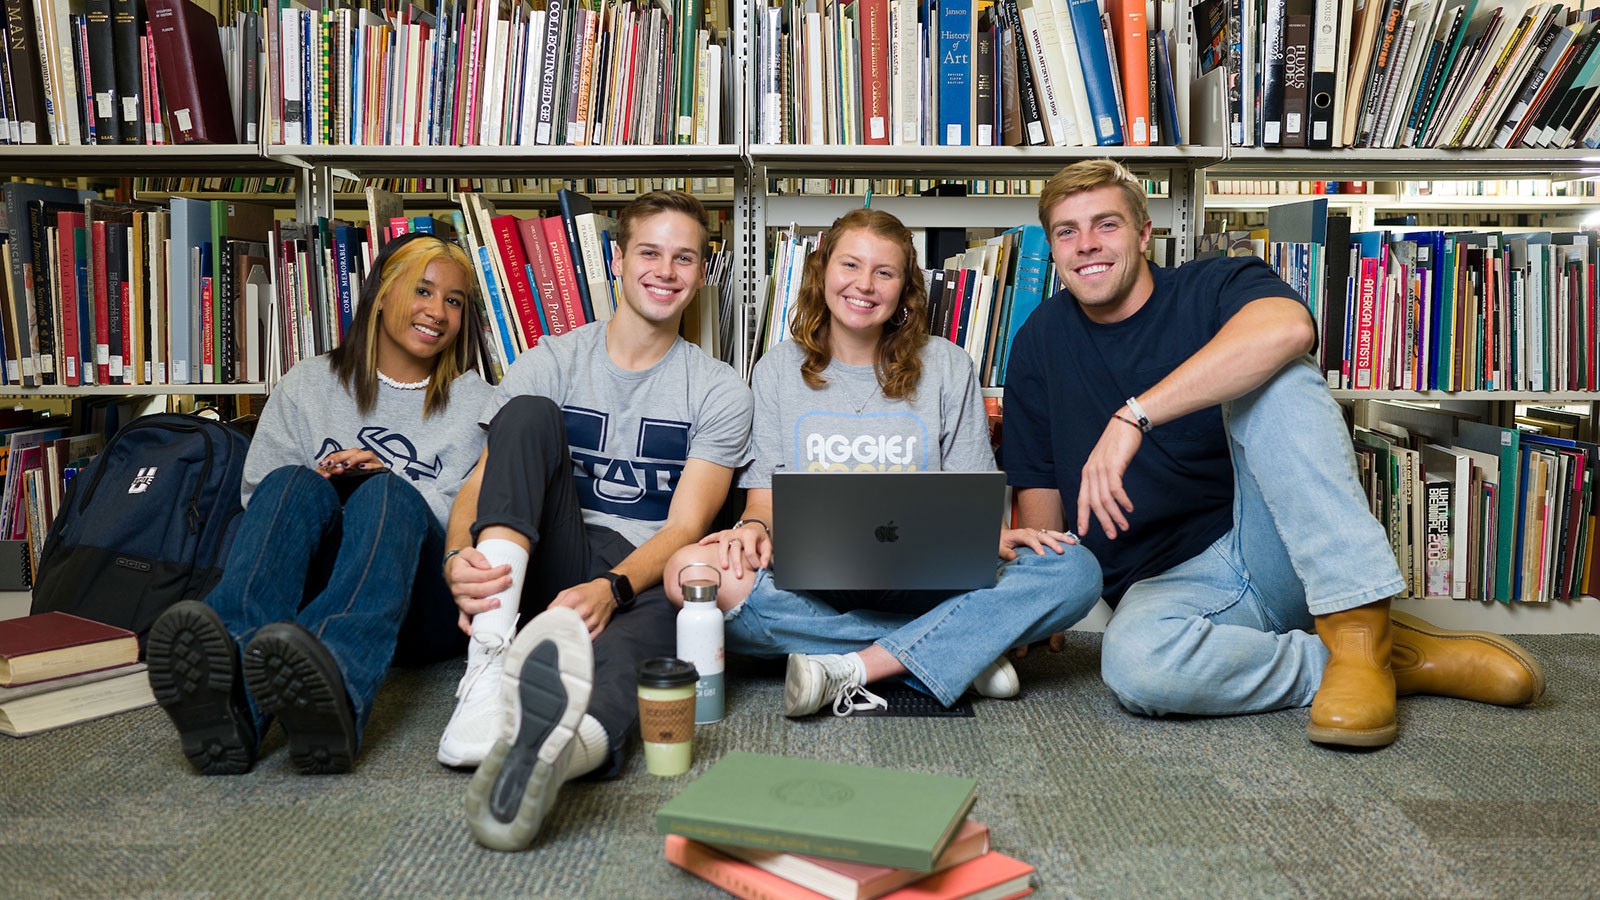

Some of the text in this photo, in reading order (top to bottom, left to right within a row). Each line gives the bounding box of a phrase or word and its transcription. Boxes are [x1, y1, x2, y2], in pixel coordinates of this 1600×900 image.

[7, 0, 26, 50] MAN
[945, 7, 967, 16] Janson
[1324, 0, 1332, 22] UXUS
[941, 30, 970, 43] History
[952, 41, 960, 51] of
[1032, 29, 1043, 55] WOMEN
[1378, 9, 1400, 67] Deep Storage
[1544, 32, 1555, 45] Pop
[540, 1, 560, 122] COLLECTING EDGE
[870, 6, 882, 117] Armand Hammer Collectio
[943, 51, 969, 65] Art
[1017, 34, 1026, 60] ANCIENT
[1028, 88, 1038, 119] PORTFOLIO
[1285, 46, 1296, 87] CODEX
[1295, 45, 1306, 89] FLUXUS
[30, 207, 40, 238] Isadora
[10, 229, 21, 276] DANCERS
[32, 240, 42, 272] Duncan
[549, 241, 567, 286] pushkin
[586, 248, 596, 279] MUSEUM
[338, 243, 350, 314] CORPS MEMORABLE
[501, 227, 538, 345] TREASURES OF THE VATIC
[542, 280, 555, 300] The
[64, 283, 72, 321] CIRQUE
[548, 303, 564, 334] Prado
[110, 316, 119, 334] Book
[1359, 278, 1374, 367] AMERICAN ARTISTS
[806, 433, 917, 469] AGGIES
[1428, 488, 1440, 567] BIENNIAL 2006
[1438, 487, 1449, 532] WHITNEY
[117, 558, 150, 570] OGIO
